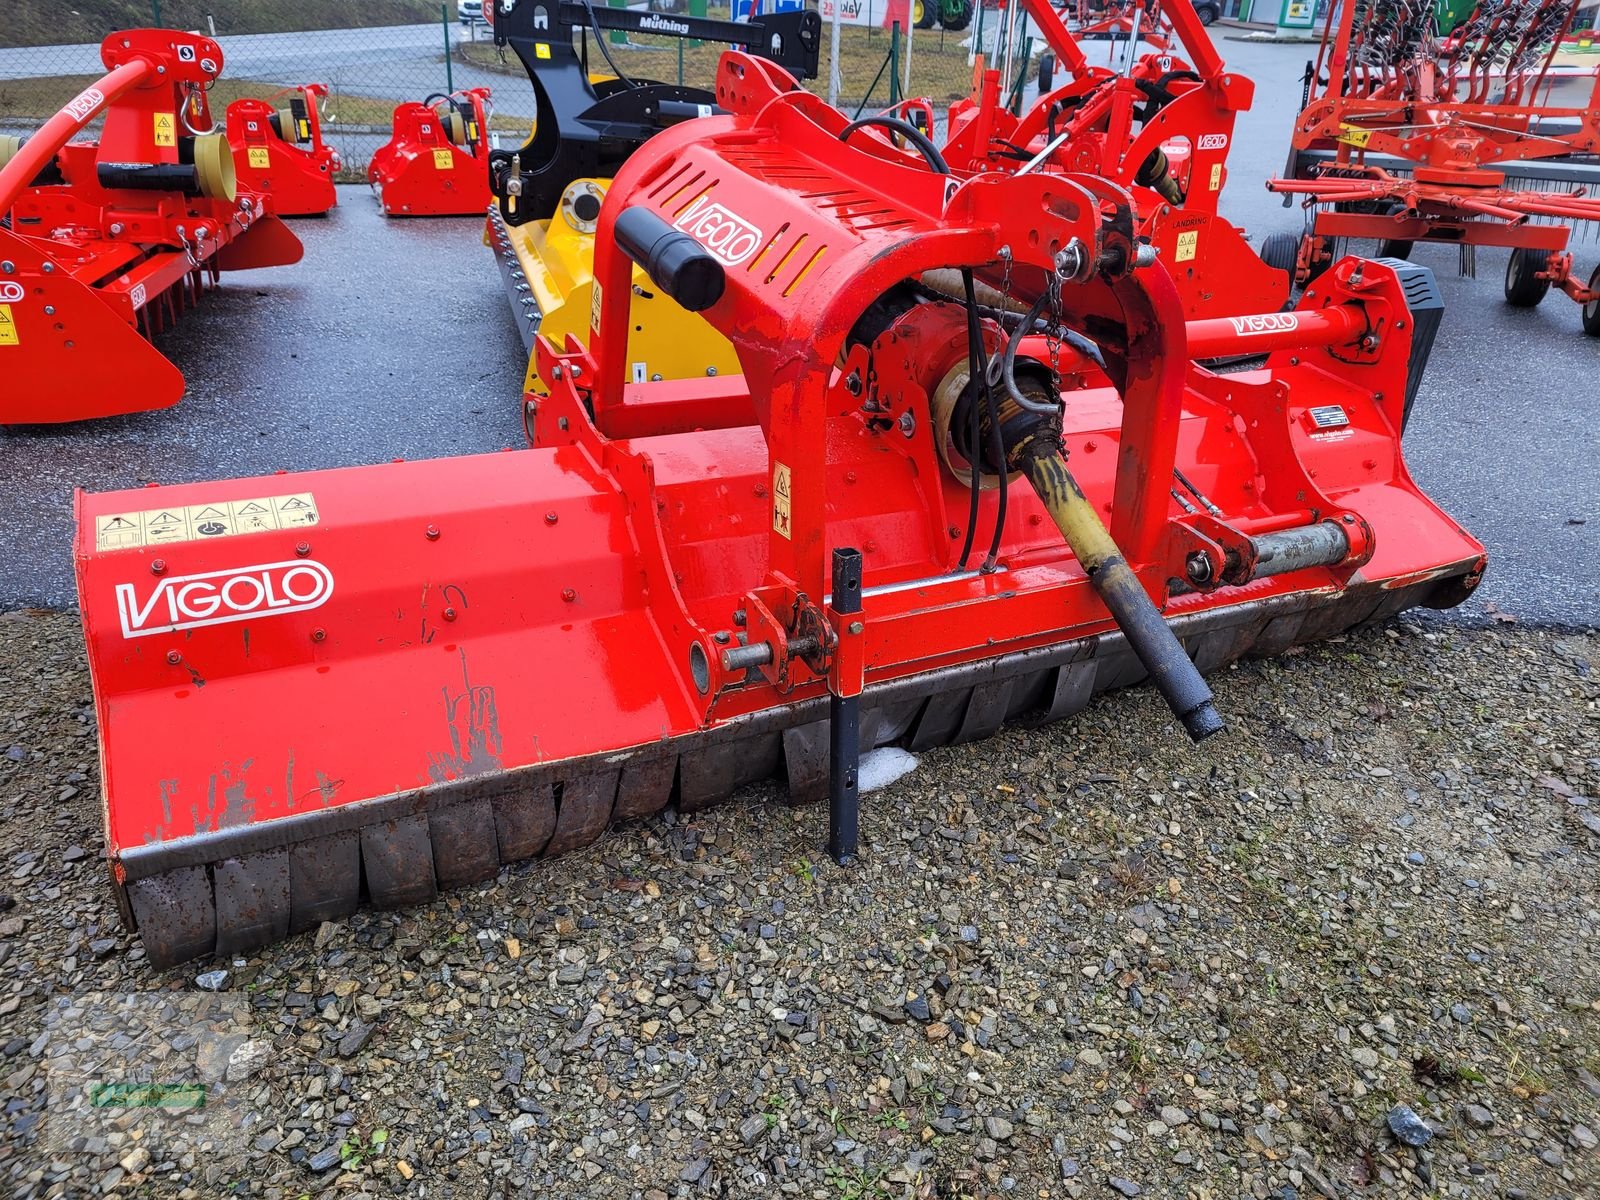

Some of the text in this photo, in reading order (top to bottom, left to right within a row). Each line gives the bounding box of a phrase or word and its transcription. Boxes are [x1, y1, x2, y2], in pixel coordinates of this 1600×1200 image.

[640, 14, 690, 34] Müthing
[62, 88, 104, 122] VIGOLO
[1197, 133, 1228, 150] VIGOLO
[672, 195, 762, 266] VIGOLO
[1229, 312, 1299, 336] VIGOLO
[115, 560, 334, 638] VIGOLO
